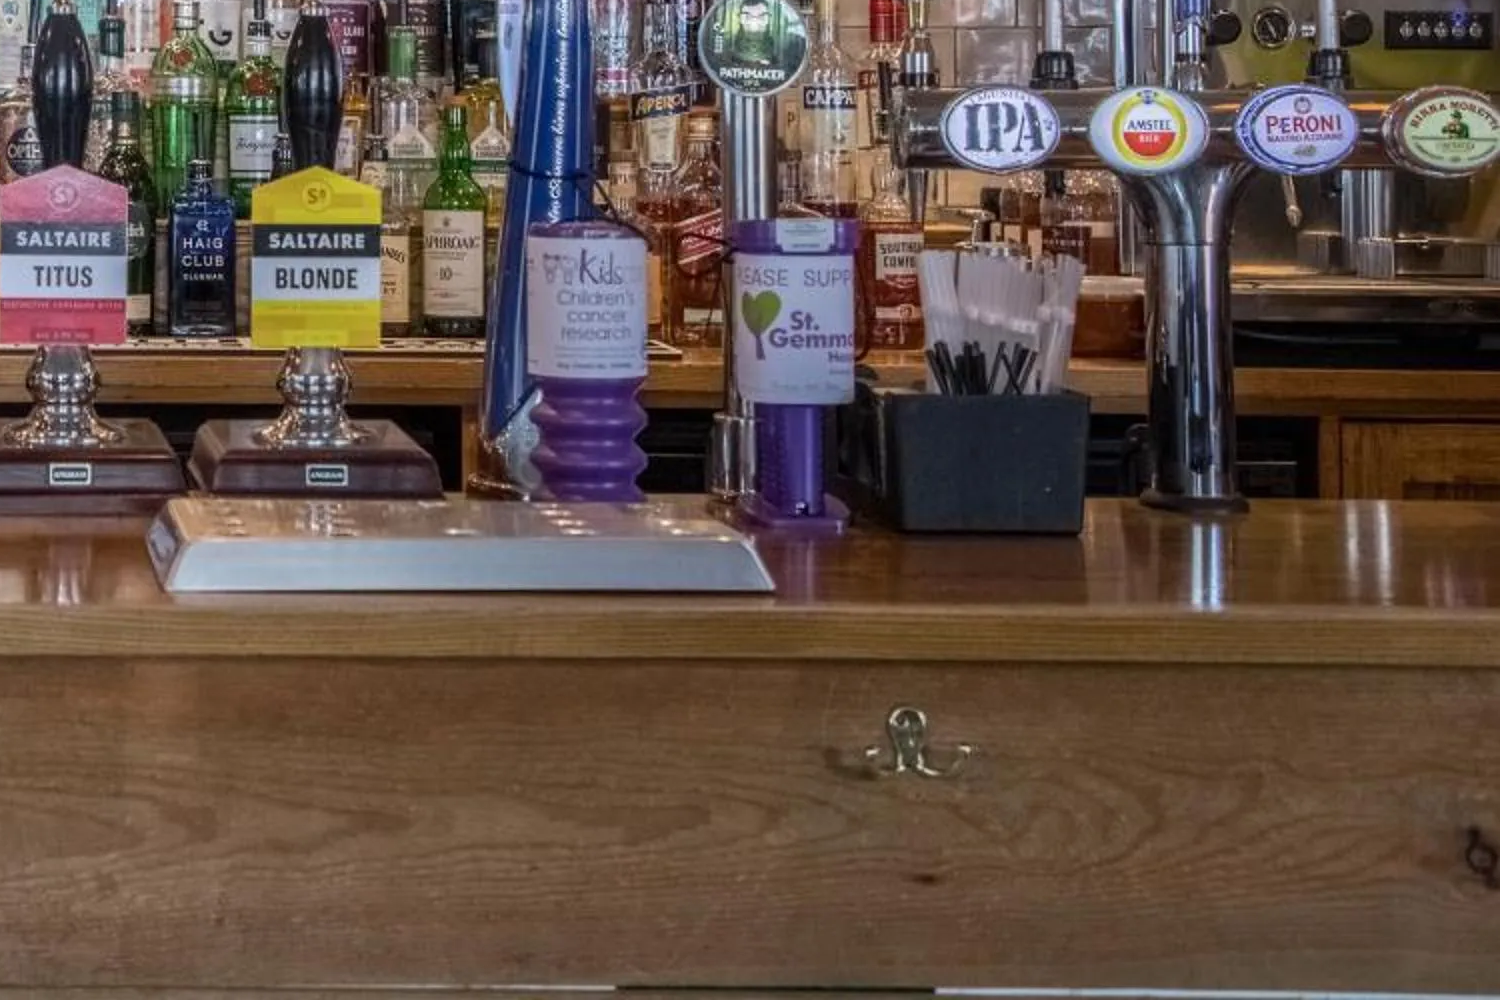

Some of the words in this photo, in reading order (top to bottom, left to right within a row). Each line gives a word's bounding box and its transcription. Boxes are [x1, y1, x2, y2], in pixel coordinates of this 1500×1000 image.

[720, 68, 786, 82] PATHMAKER
[963, 102, 1048, 151] IPA
[1127, 119, 1173, 131] AMSTEL
[1266, 115, 1342, 133] PERONI
[16, 231, 112, 249] SALTAIRE
[182, 236, 224, 250] HAIG
[268, 232, 366, 249] SALTAIRE
[181, 255, 225, 268] CLUB
[579, 248, 624, 285] Kids
[33, 265, 93, 288] TITUS
[275, 267, 358, 290] BLONDE
[556, 287, 636, 306] Children's
[566, 308, 627, 323] cancer
[790, 310, 820, 331] St.
[560, 326, 632, 341] research
